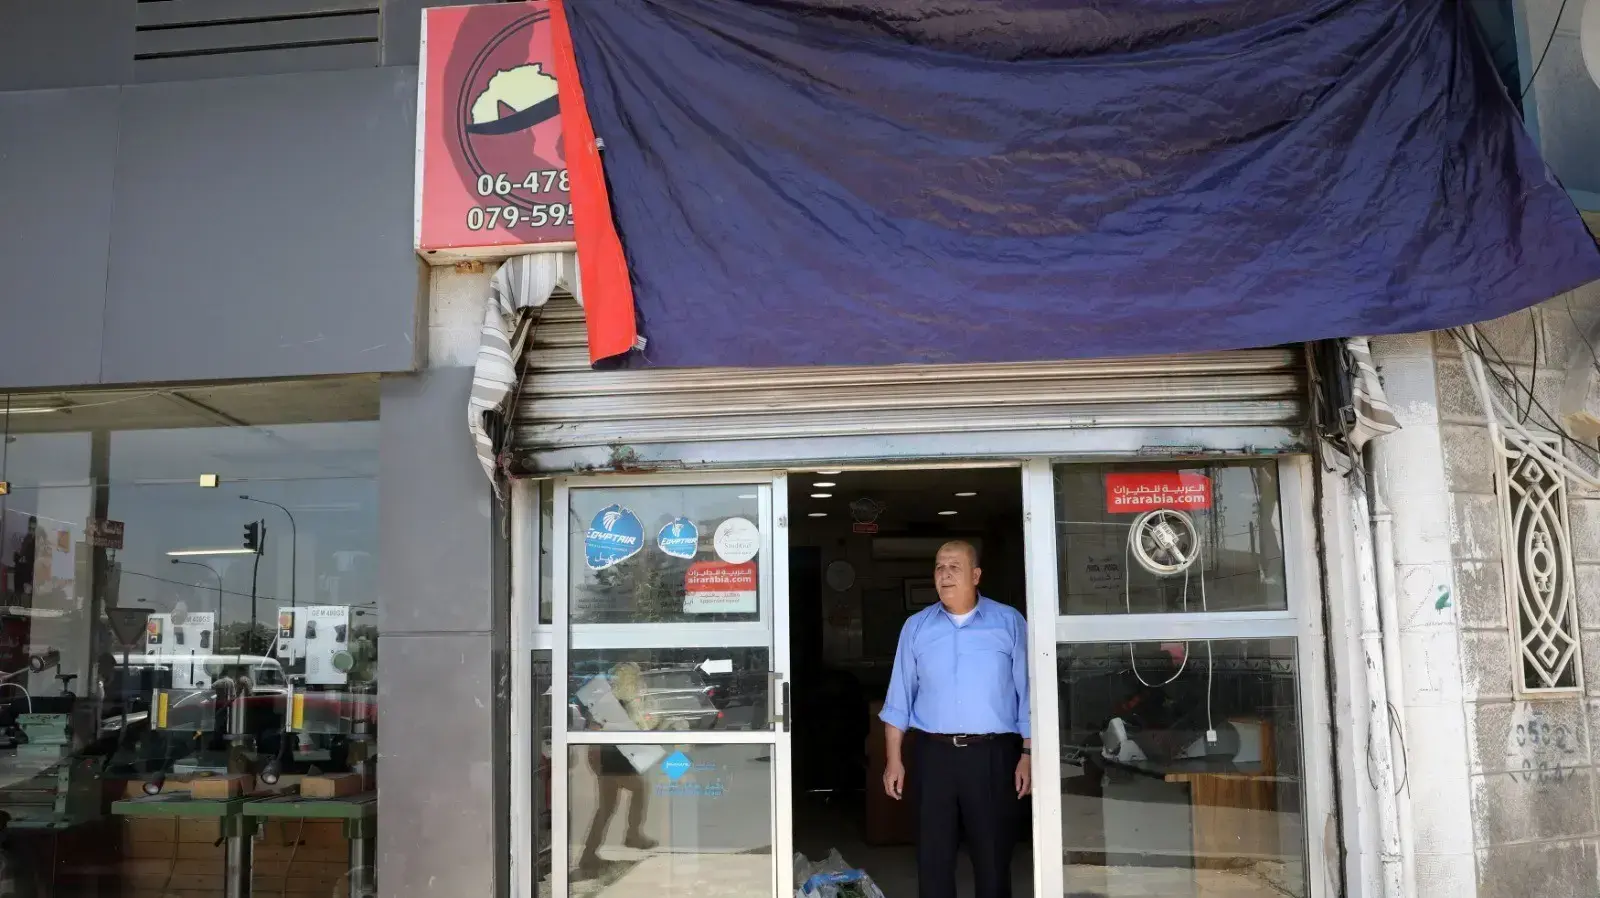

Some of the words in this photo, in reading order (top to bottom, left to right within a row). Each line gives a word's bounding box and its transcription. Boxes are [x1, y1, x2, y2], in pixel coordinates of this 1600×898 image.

[477, 169, 570, 196] 06-478
[1162, 484, 1204, 494] العربية
[1115, 493, 1205, 505] airarabia.com
[687, 575, 752, 584] airarabia.com
